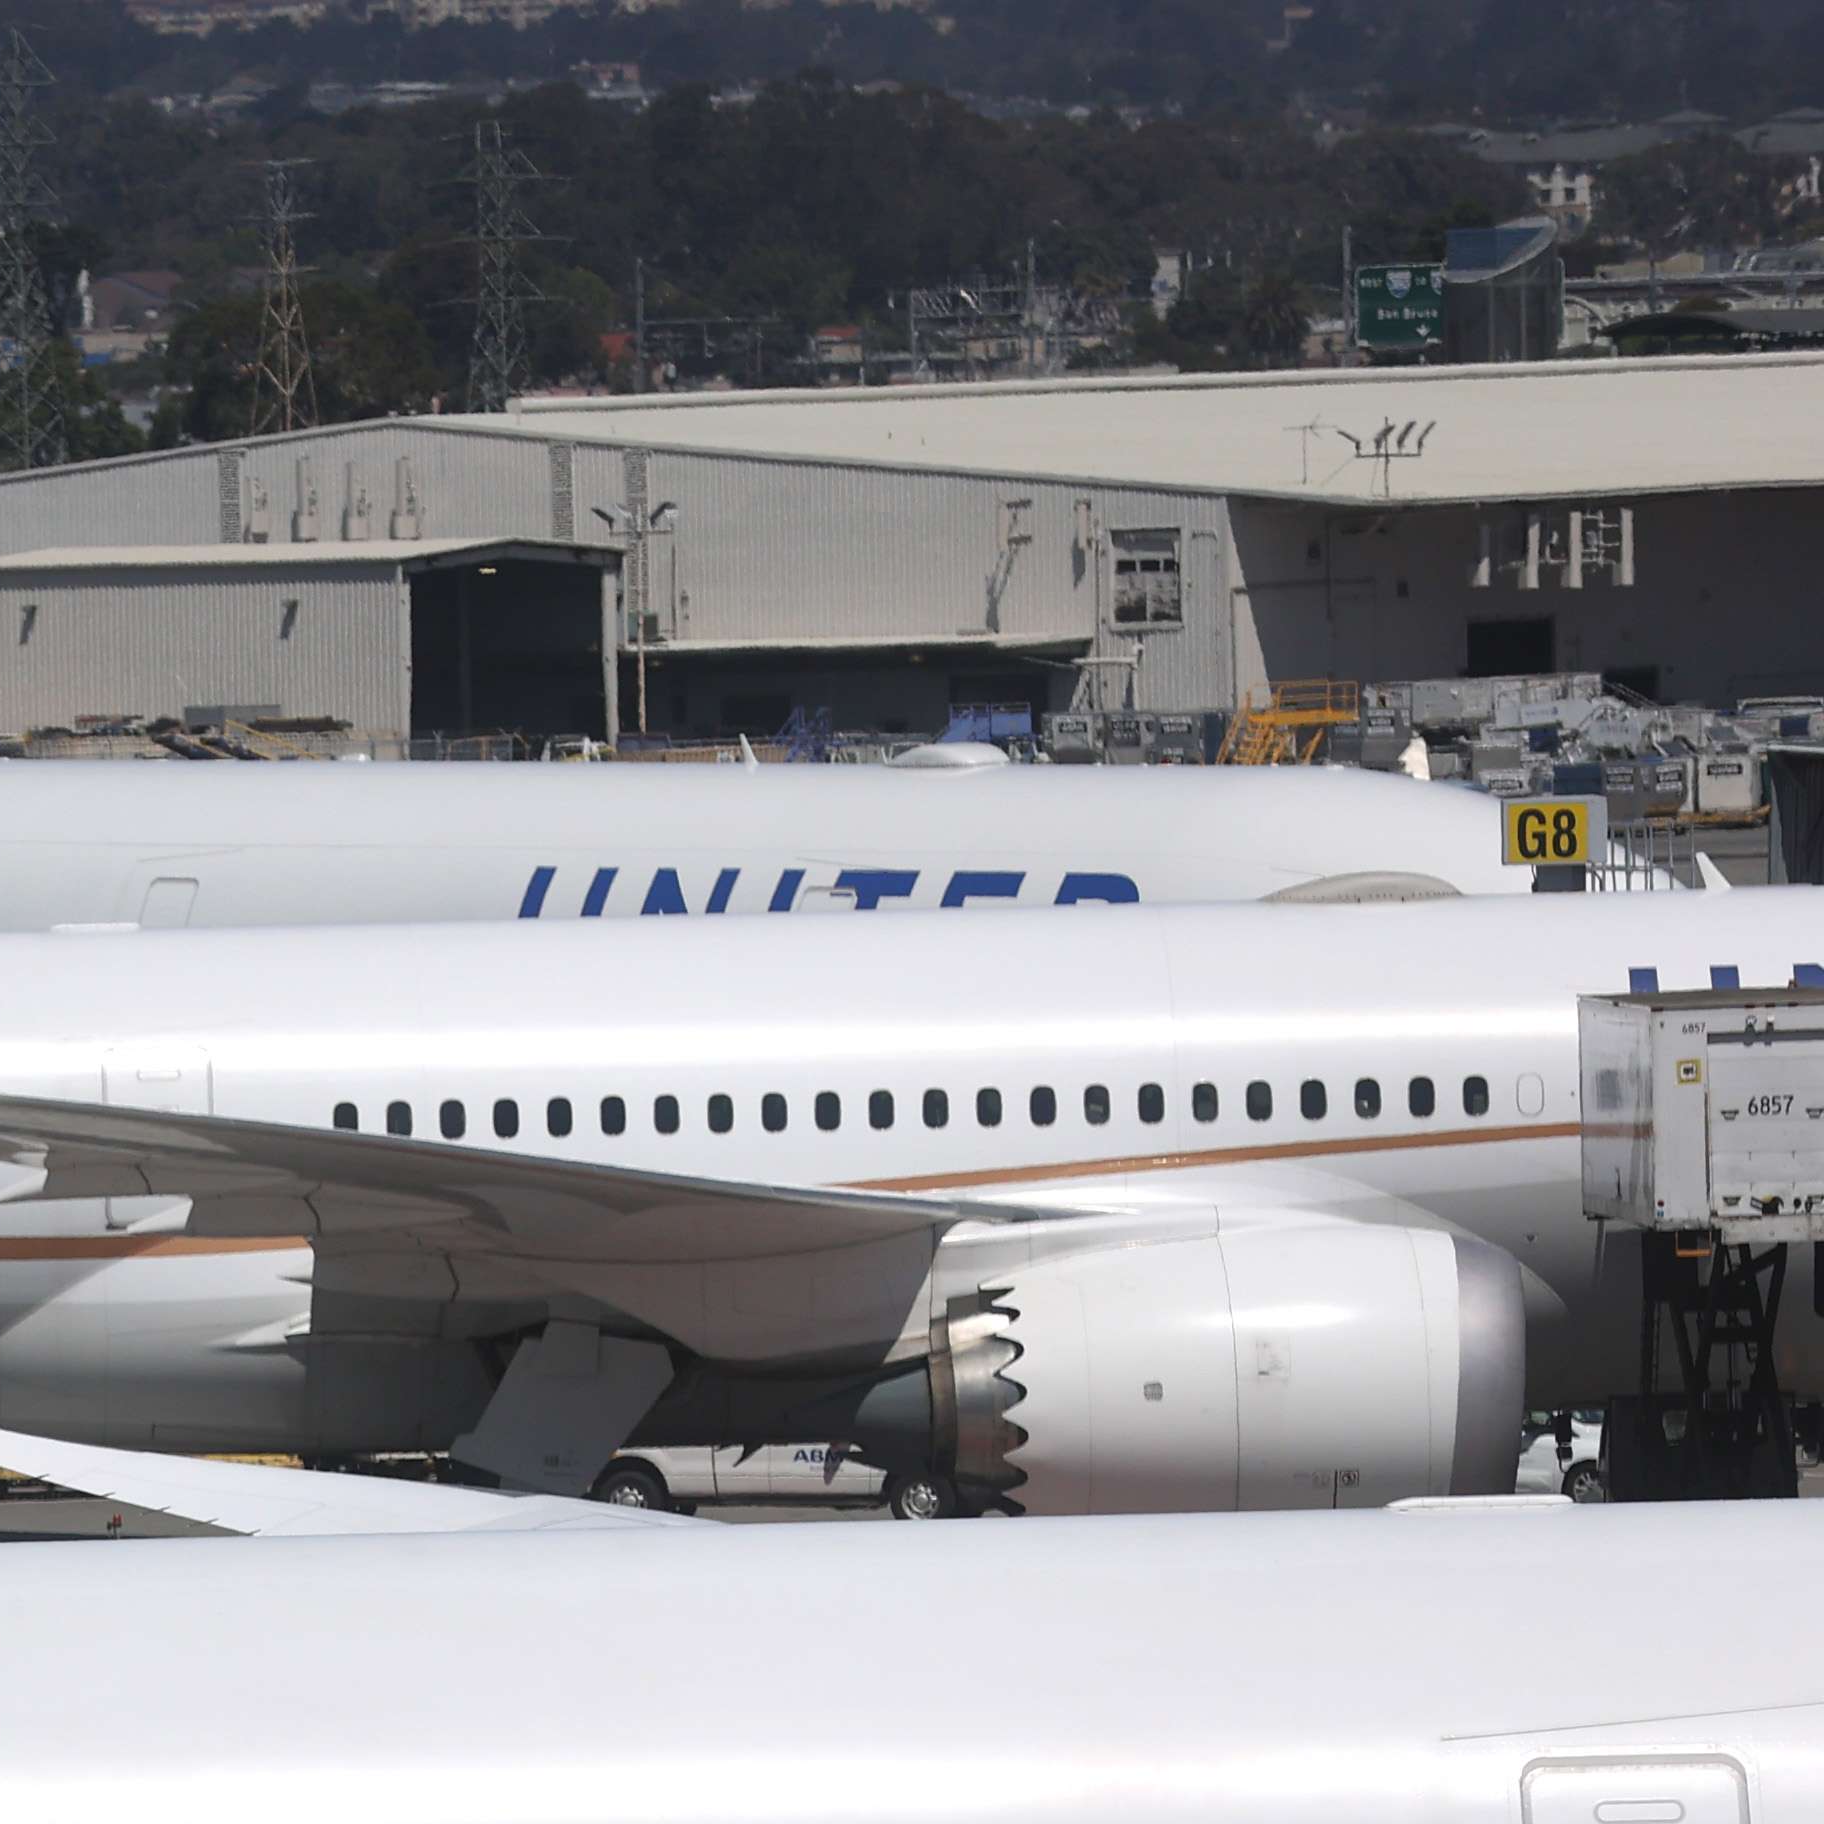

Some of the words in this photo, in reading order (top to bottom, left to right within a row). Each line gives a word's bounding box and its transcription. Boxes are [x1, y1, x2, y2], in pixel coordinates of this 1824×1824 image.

[1517, 808, 1578, 859] G8
[1682, 1022, 1706, 1035] 6857
[1747, 1095, 1795, 1116] 6857
